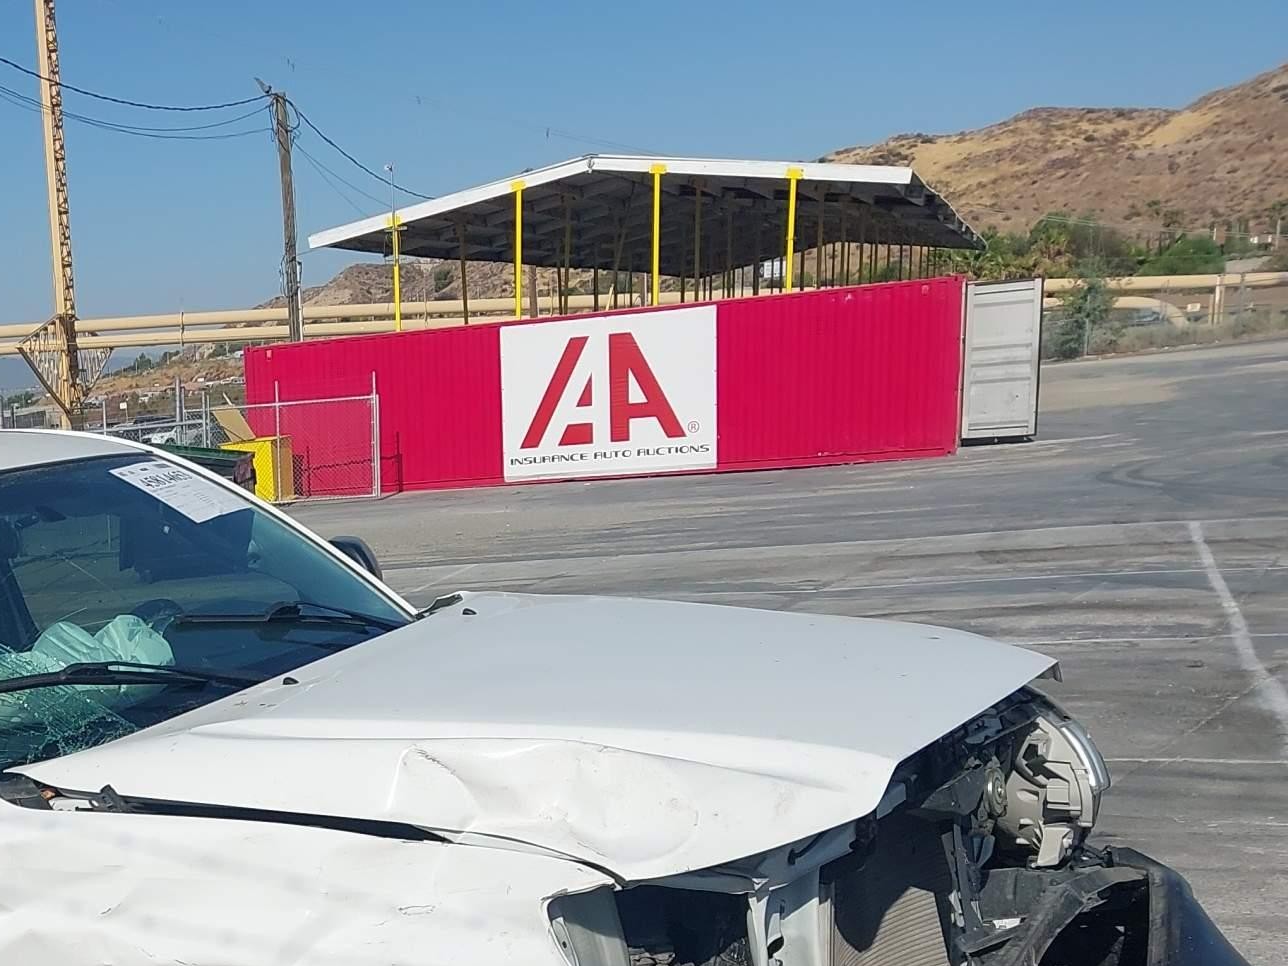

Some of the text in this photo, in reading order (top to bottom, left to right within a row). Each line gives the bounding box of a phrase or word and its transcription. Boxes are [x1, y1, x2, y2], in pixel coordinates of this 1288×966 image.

[510, 444, 711, 466] INSURANCE AUTO AUCTIONS
